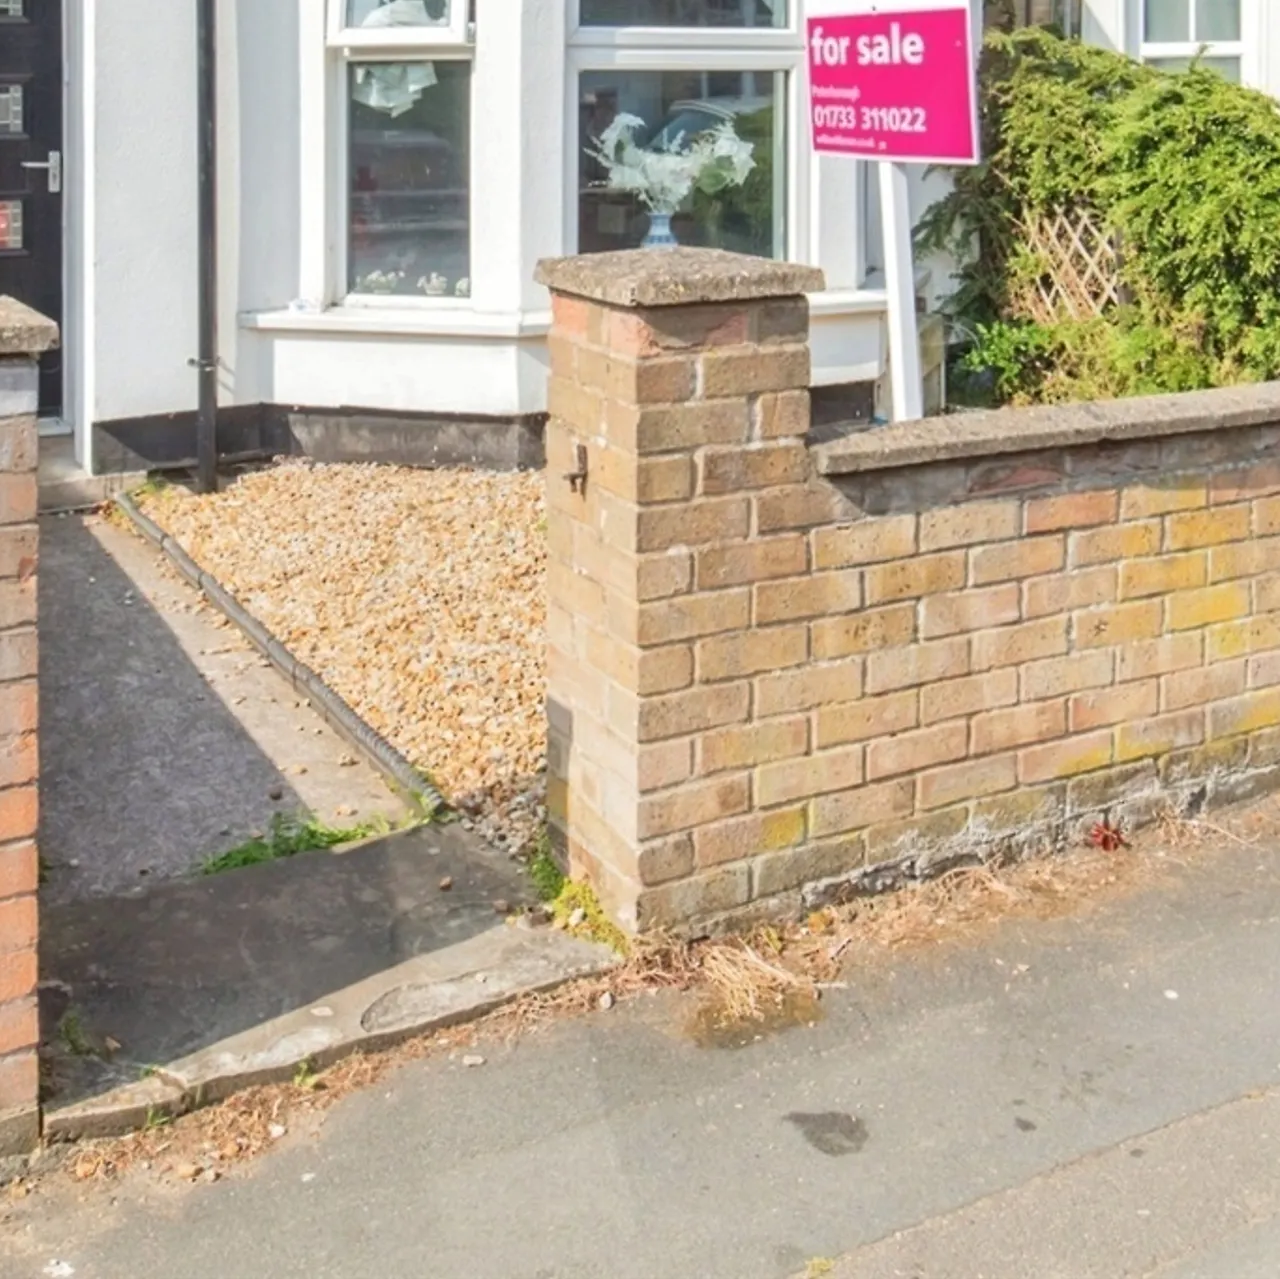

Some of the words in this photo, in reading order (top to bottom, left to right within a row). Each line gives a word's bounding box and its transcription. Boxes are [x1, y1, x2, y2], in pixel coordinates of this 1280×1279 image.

[810, 26, 850, 67] for
[856, 23, 924, 65] sale
[814, 105, 856, 130] 01733
[861, 105, 927, 132] 311022
